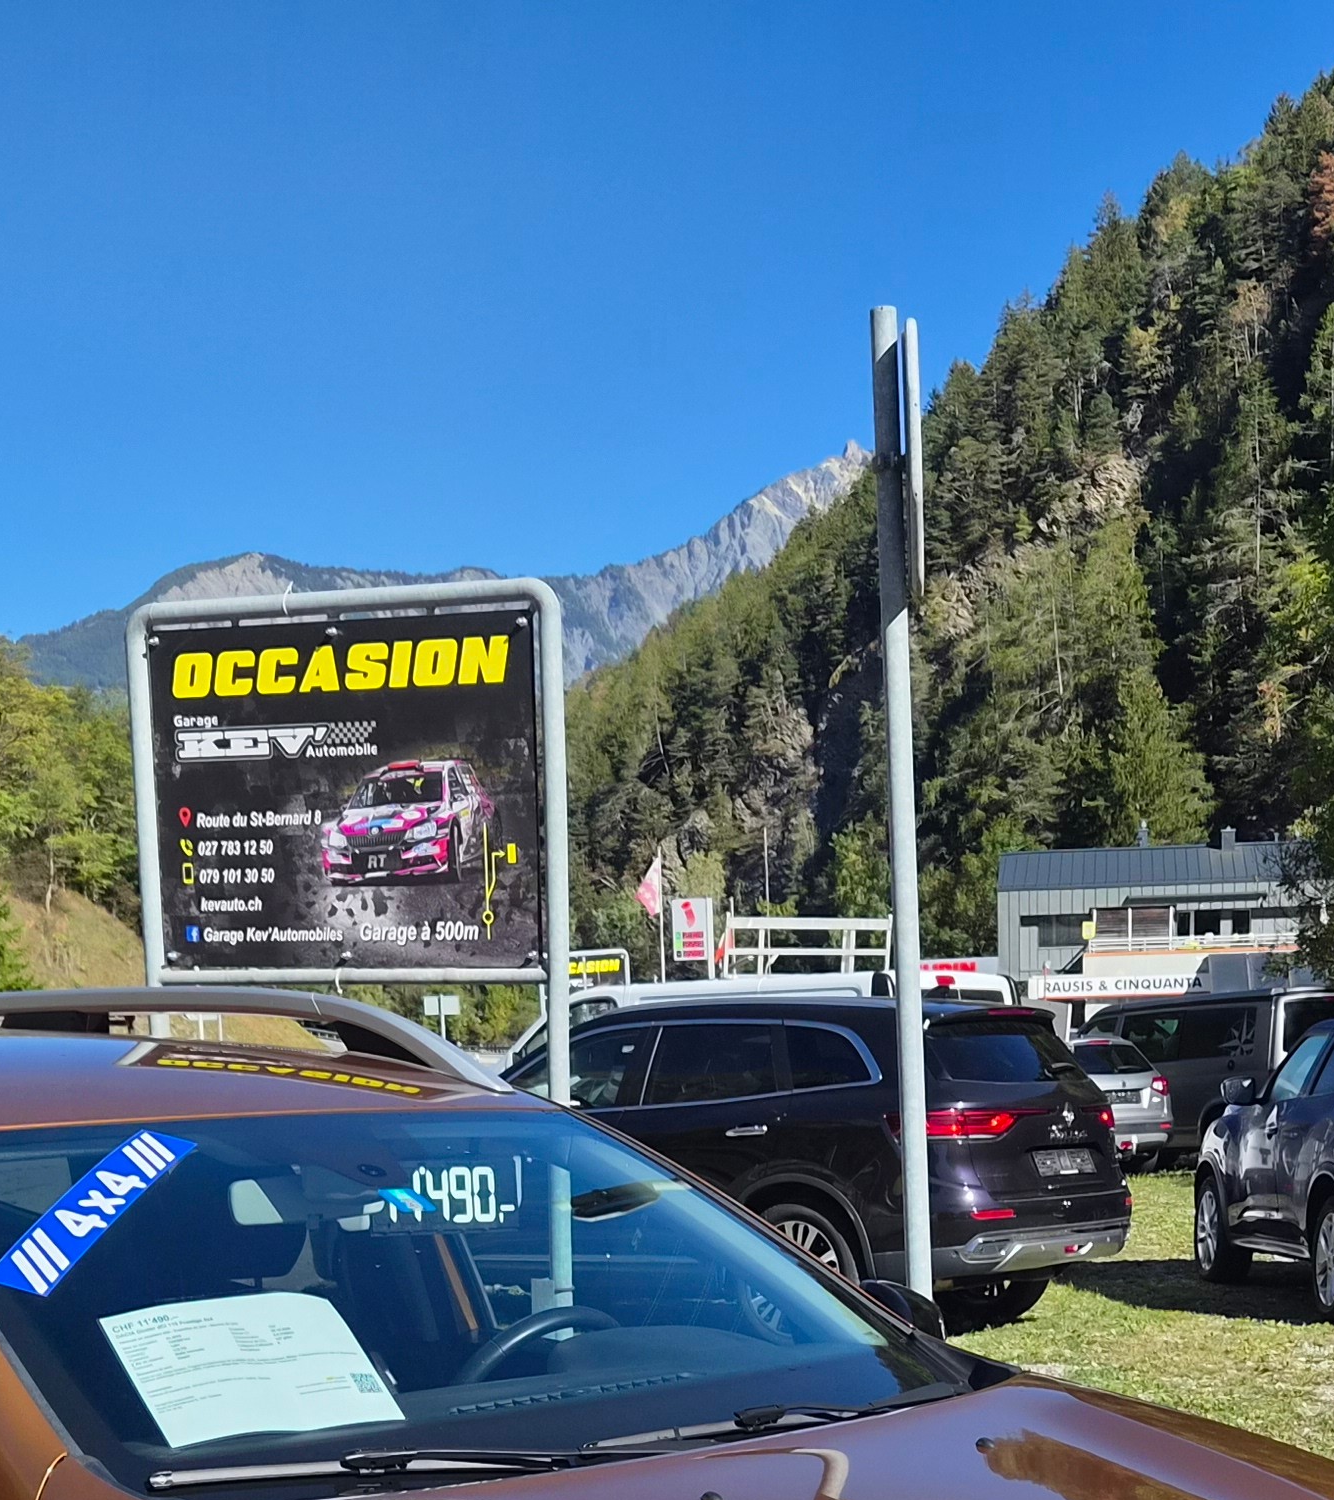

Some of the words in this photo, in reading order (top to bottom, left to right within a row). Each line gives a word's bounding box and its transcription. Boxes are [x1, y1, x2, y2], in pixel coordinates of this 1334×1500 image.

[172, 635, 509, 699] OCCASION
[173, 715, 218, 729] Garage
[306, 744, 378, 757] Automobile
[196, 812, 230, 827] Route
[233, 812, 247, 826] du
[250, 811, 311, 827] St-Bernard
[314, 811, 321, 825] 8
[197, 841, 220, 856] 027
[222, 841, 242, 855] 783
[245, 840, 257, 855] 12
[259, 840, 273, 854] 50
[367, 854, 387, 869] RT
[199, 869, 222, 884] 079
[225, 869, 243, 883] 101
[245, 869, 258, 883] 30
[260, 868, 275, 882] 50
[200, 896, 263, 913] kevauto.ch
[204, 928, 244, 944] Garage
[246, 927, 343, 943] Kev'Automobiles
[360, 923, 418, 944] Garage
[421, 921, 431, 941] à
[435, 921, 479, 941] 500m
[569, 959, 620, 975] CASION
[1045, 981, 1093, 993] RAUSIS
[1098, 982, 1108, 991] &
[1114, 976, 1202, 991] CINQUANTA
[54, 1169, 147, 1239] 4x4
